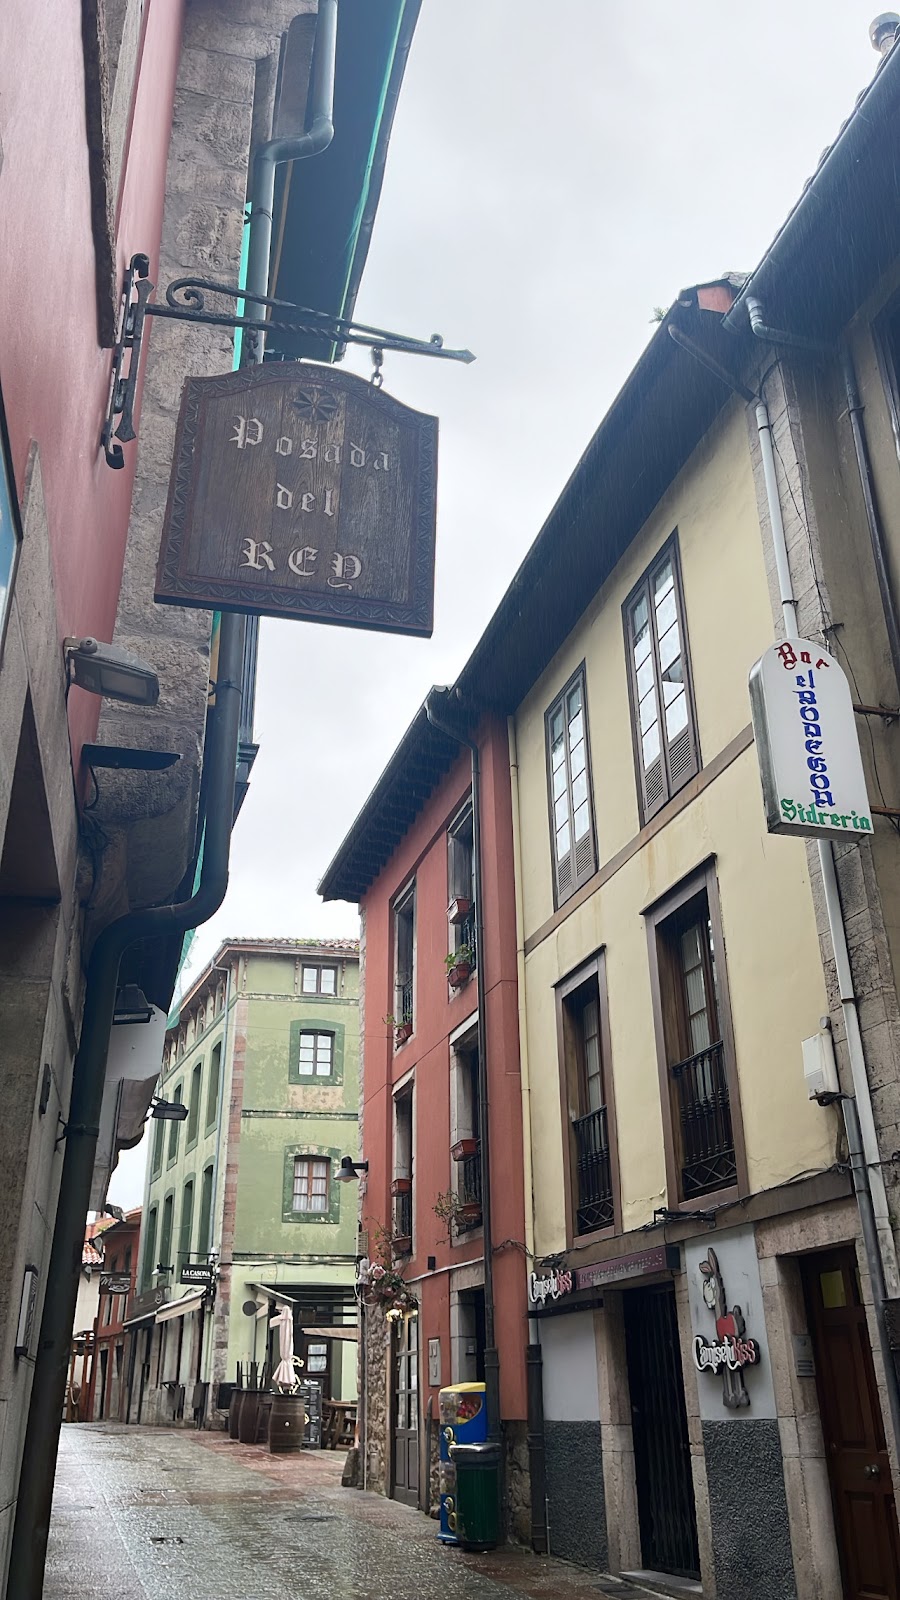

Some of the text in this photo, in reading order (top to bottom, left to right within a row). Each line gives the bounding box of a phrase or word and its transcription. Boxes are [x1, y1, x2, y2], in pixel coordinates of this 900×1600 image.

[229, 415, 390, 471] Posada
[276, 483, 334, 516] del
[240, 538, 362, 590] REY
[774, 642, 829, 670] Bar
[796, 669, 815, 689] el
[781, 798, 871, 831] Sidreria
